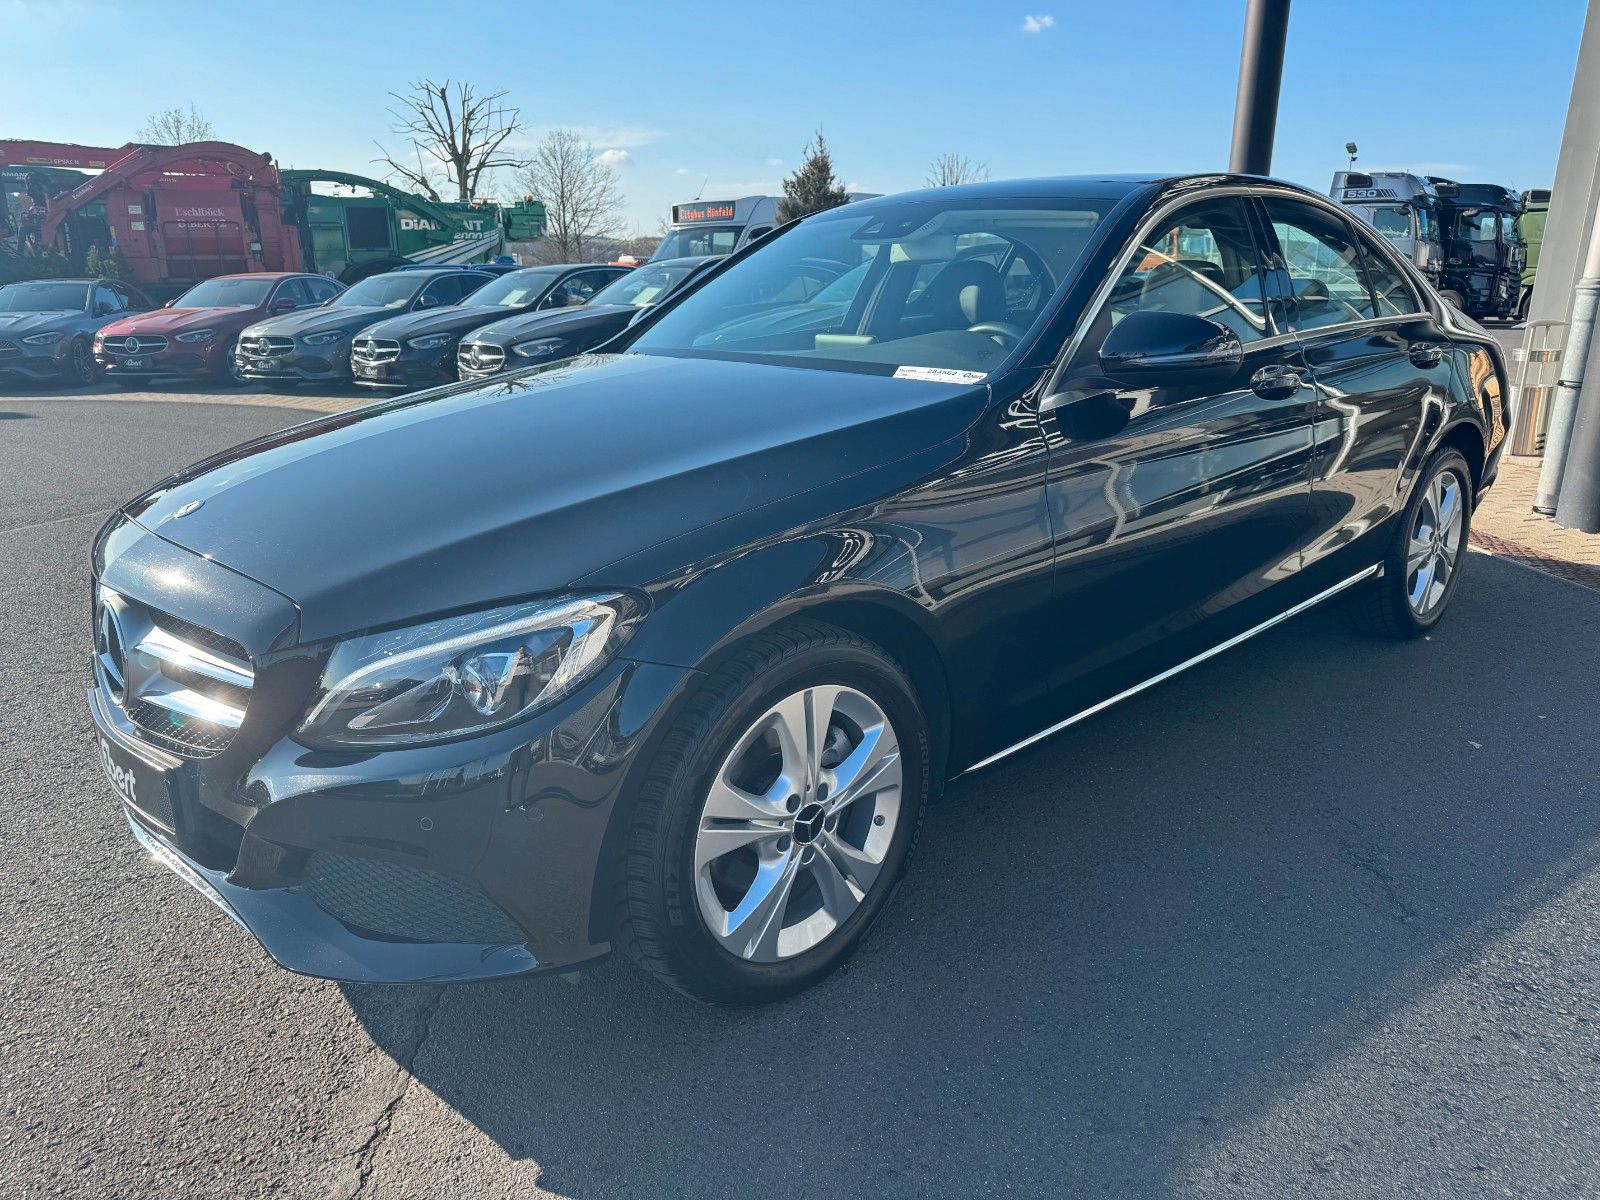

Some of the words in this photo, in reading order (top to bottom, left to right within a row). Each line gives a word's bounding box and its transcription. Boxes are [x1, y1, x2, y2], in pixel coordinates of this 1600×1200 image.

[1347, 190, 1378, 198] 530
[175, 206, 225, 217] Eschlböck
[680, 209, 705, 220] Citybus
[706, 206, 733, 218] Hünfeld
[401, 218, 484, 231] DiAMNT
